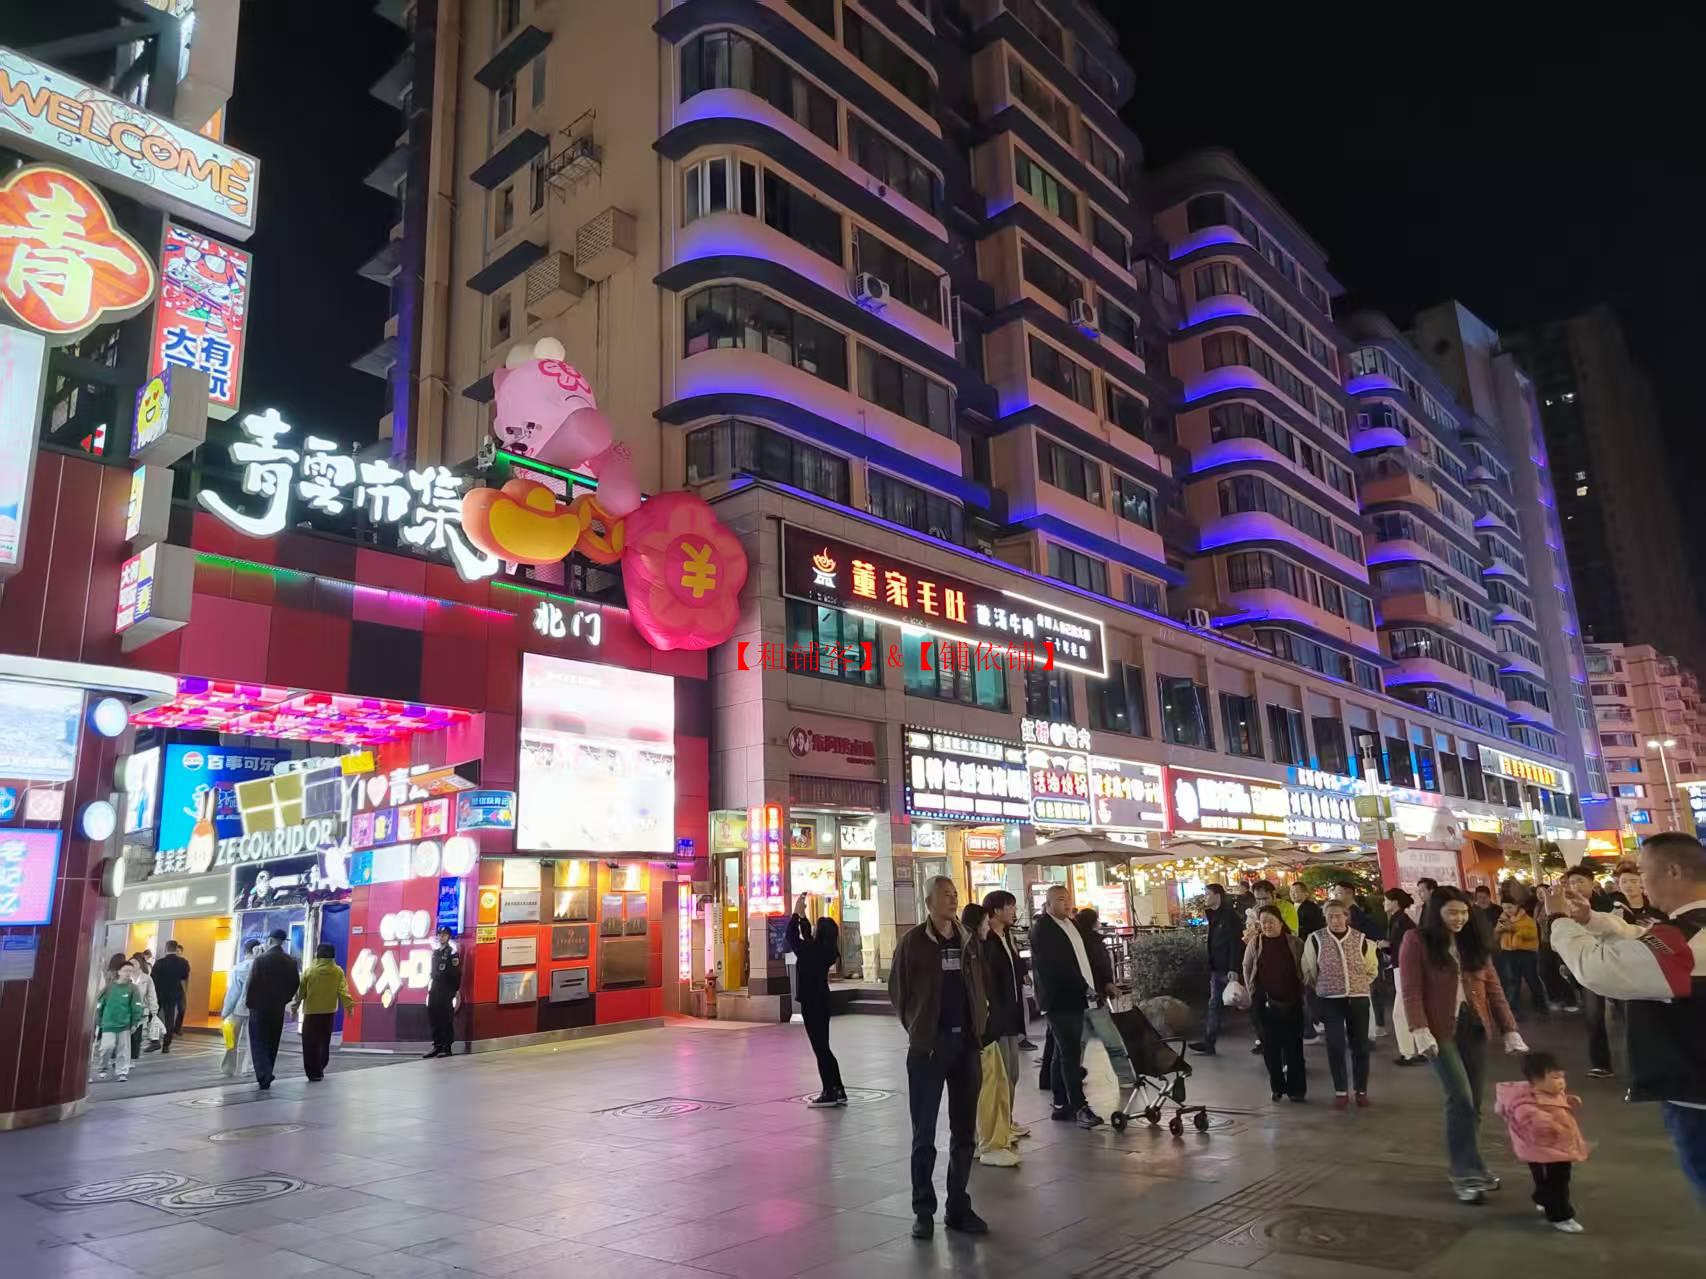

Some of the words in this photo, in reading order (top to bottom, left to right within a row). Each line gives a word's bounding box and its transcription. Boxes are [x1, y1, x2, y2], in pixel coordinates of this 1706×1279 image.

[0, 68, 249, 203] WELCOME
[0, 181, 137, 324] 青
[533, 602, 602, 645] 北门
[850, 559, 968, 625] 董家毛肚
[207, 754, 276, 772] 百事可乐
